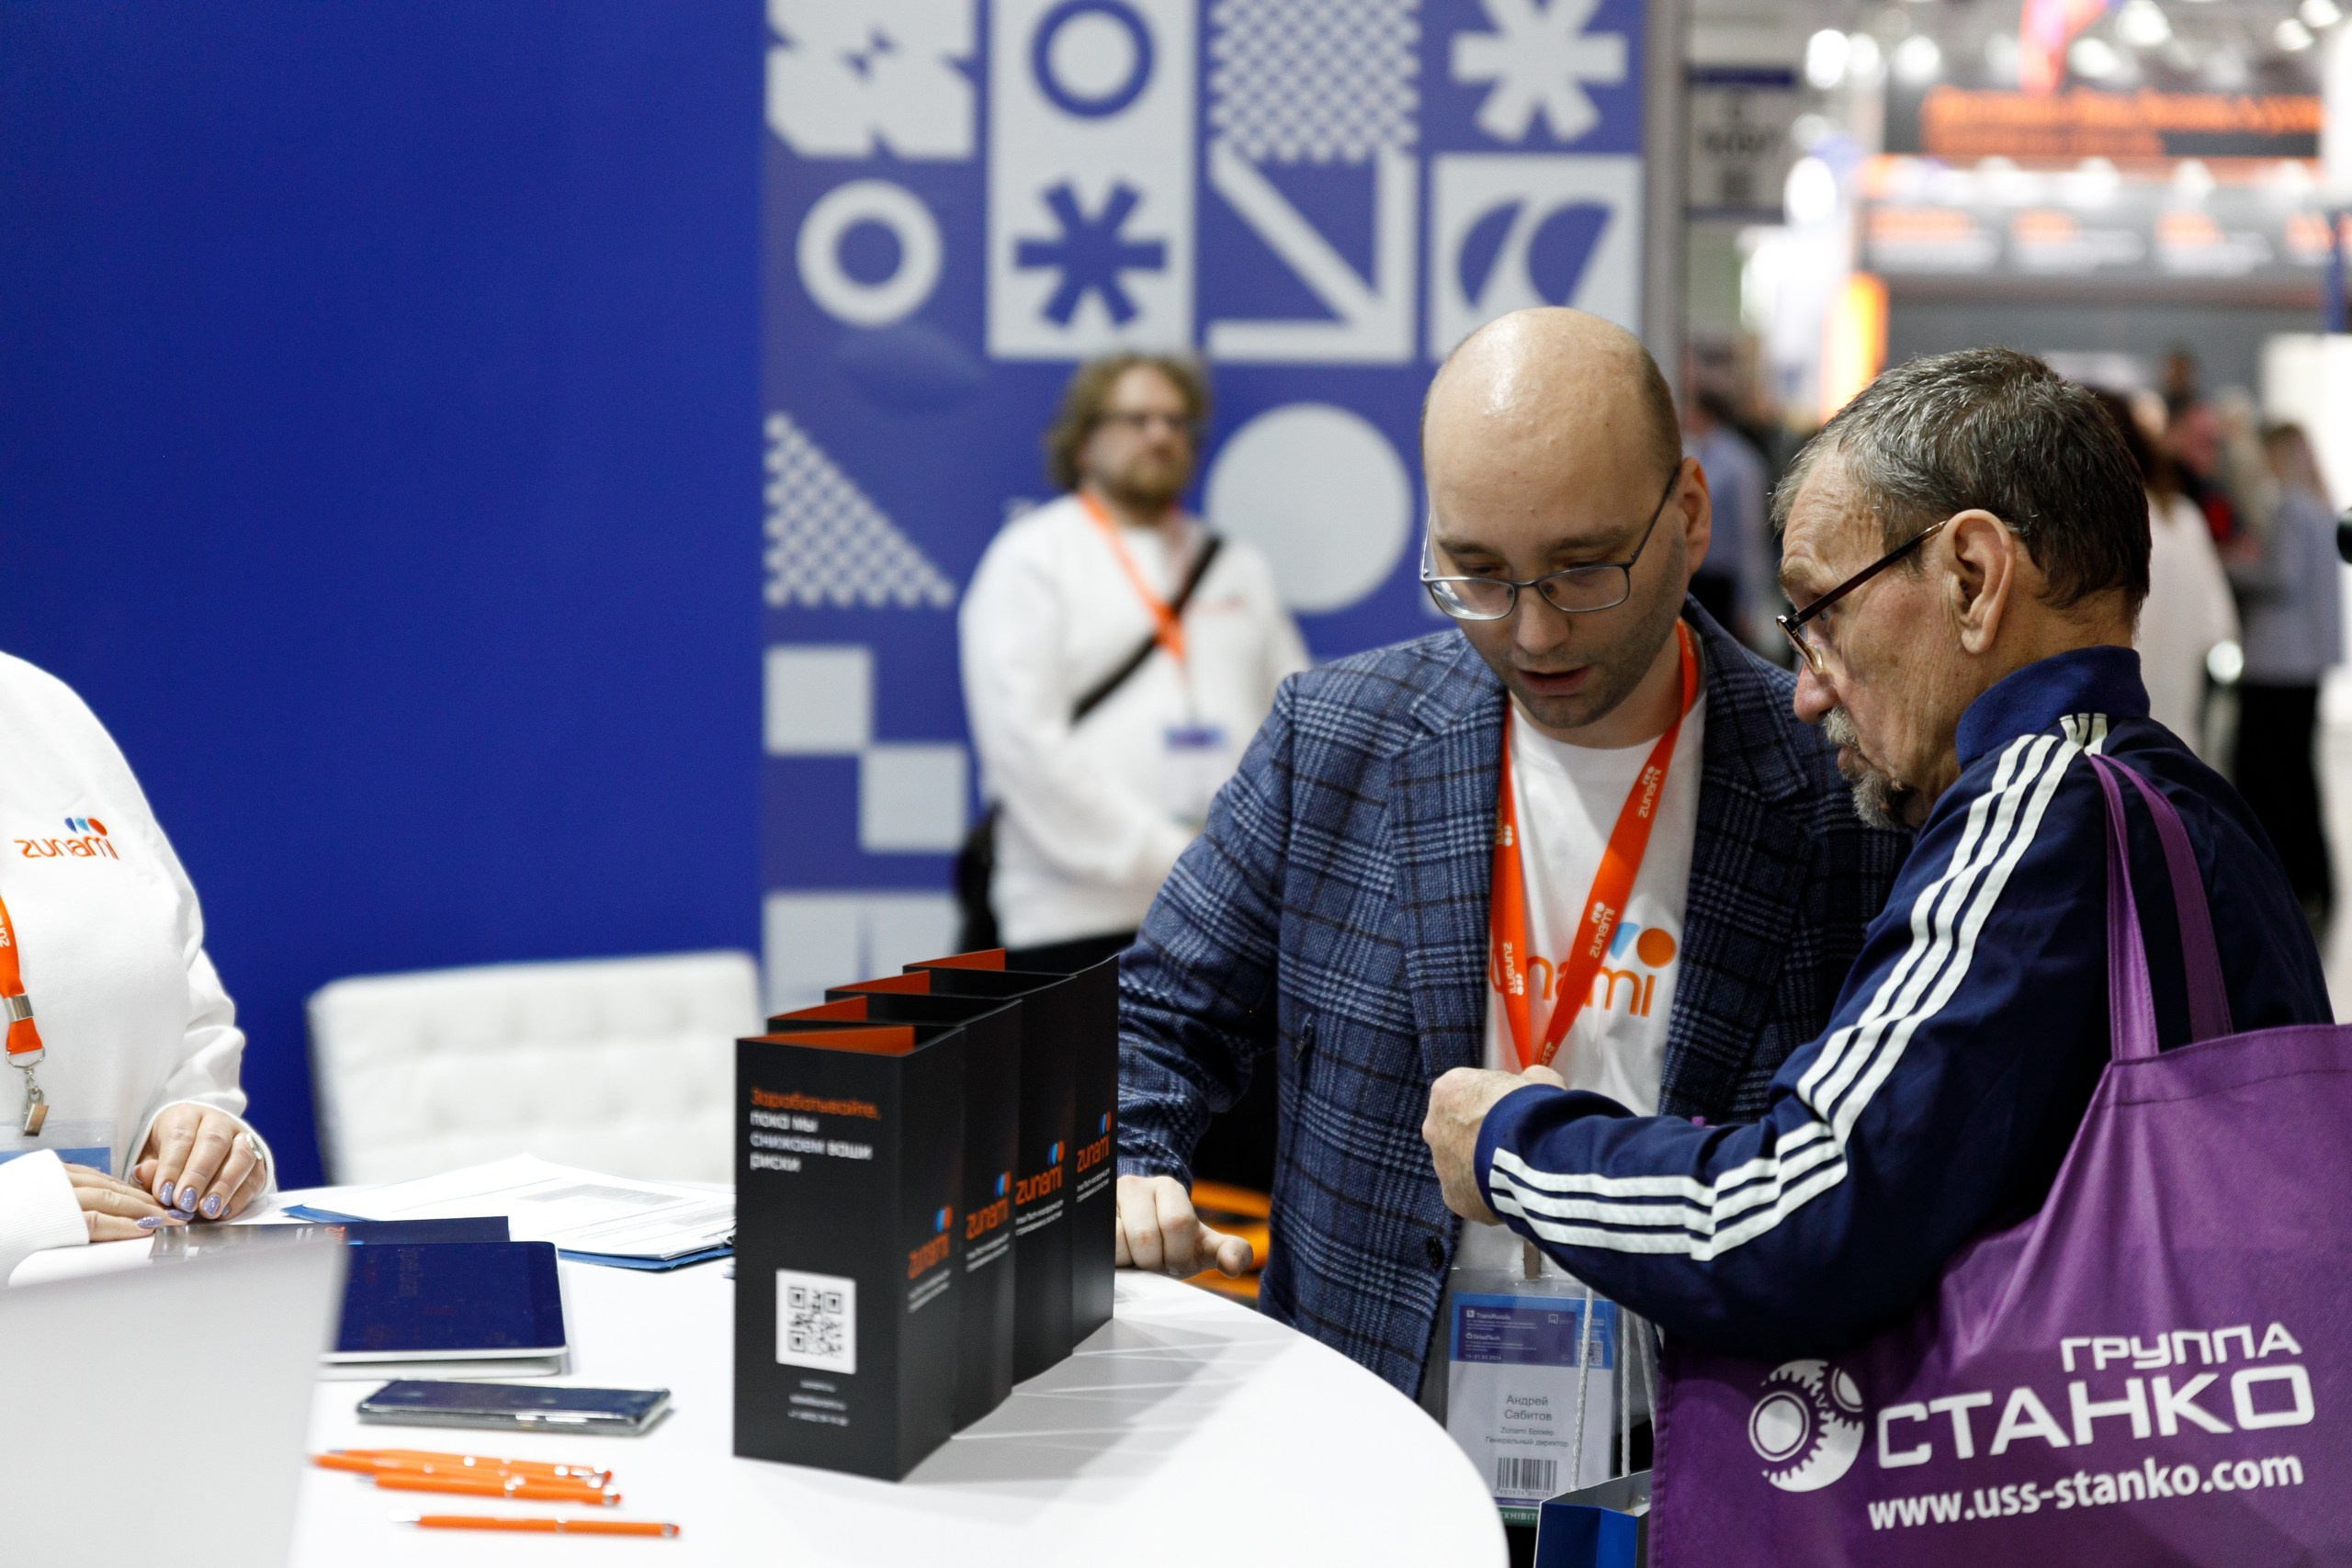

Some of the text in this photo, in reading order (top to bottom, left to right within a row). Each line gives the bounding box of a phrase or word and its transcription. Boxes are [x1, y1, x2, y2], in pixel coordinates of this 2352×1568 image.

[1638, 768, 1662, 819] zunami
[13, 837, 120, 861] zunami
[1589, 907, 1615, 959] zunami
[1502, 942, 1517, 995] zunami
[750, 1110, 819, 1133] пока мы
[750, 1131, 874, 1161] снижаем ваши
[750, 1151, 802, 1173] риски
[1077, 1134, 1110, 1174] zunami
[1015, 1164, 1063, 1205] zunami
[966, 1197, 1009, 1240] zunami
[2061, 1321, 2303, 1373] ГРУППА
[1504, 1409, 1553, 1421] Сабитов
[1506, 1394, 1549, 1407] Андрей
[1876, 1363, 2316, 1470] СТАНКО
[1486, 1436, 1569, 1448] Генеральный директор
[1500, 1427, 1555, 1437] Zunami Брокер
[1868, 1455, 2305, 1530] www.uss-stanko.com
[1499, 1511, 1540, 1521] EXHIBIT
